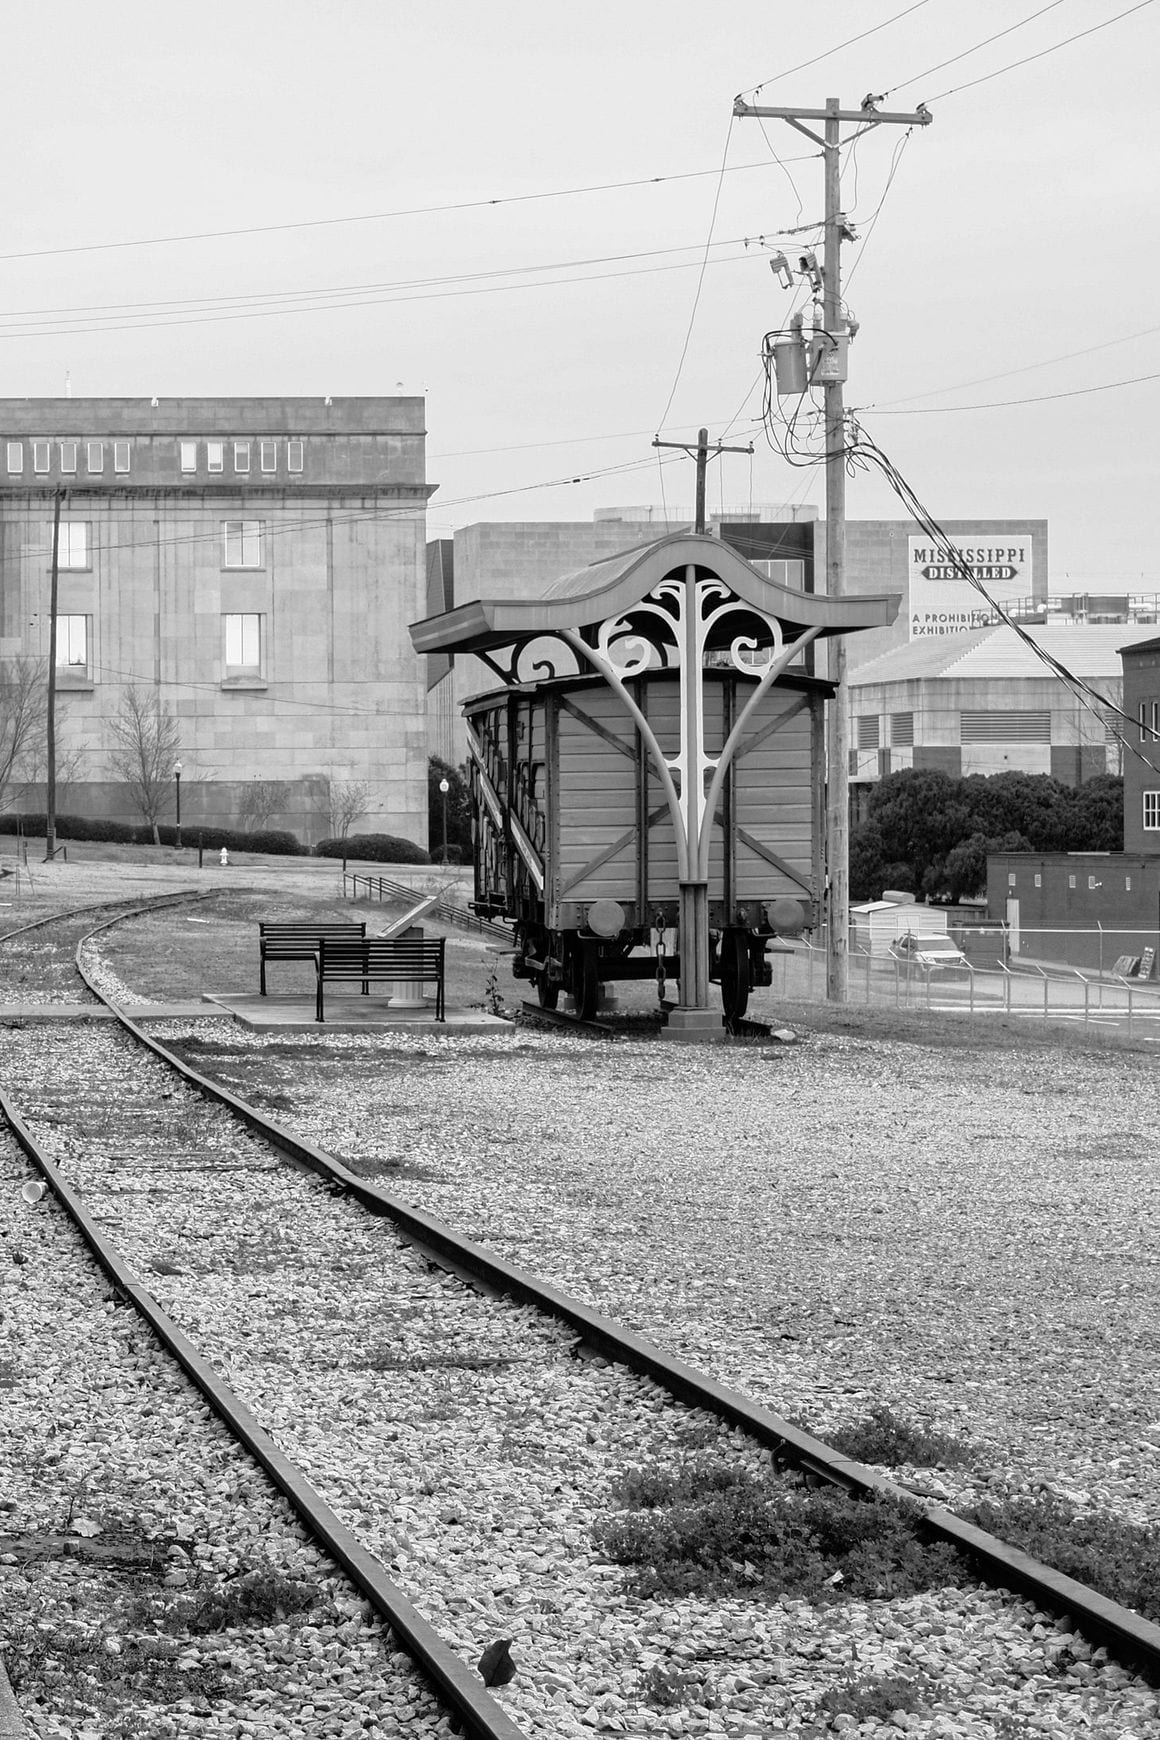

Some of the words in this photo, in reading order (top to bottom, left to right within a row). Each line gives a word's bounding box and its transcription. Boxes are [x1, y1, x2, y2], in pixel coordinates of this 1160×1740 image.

[928, 567, 1011, 579] DISTLLED
[912, 613, 920, 623] A
[912, 626, 968, 635] EXHIBITIO
